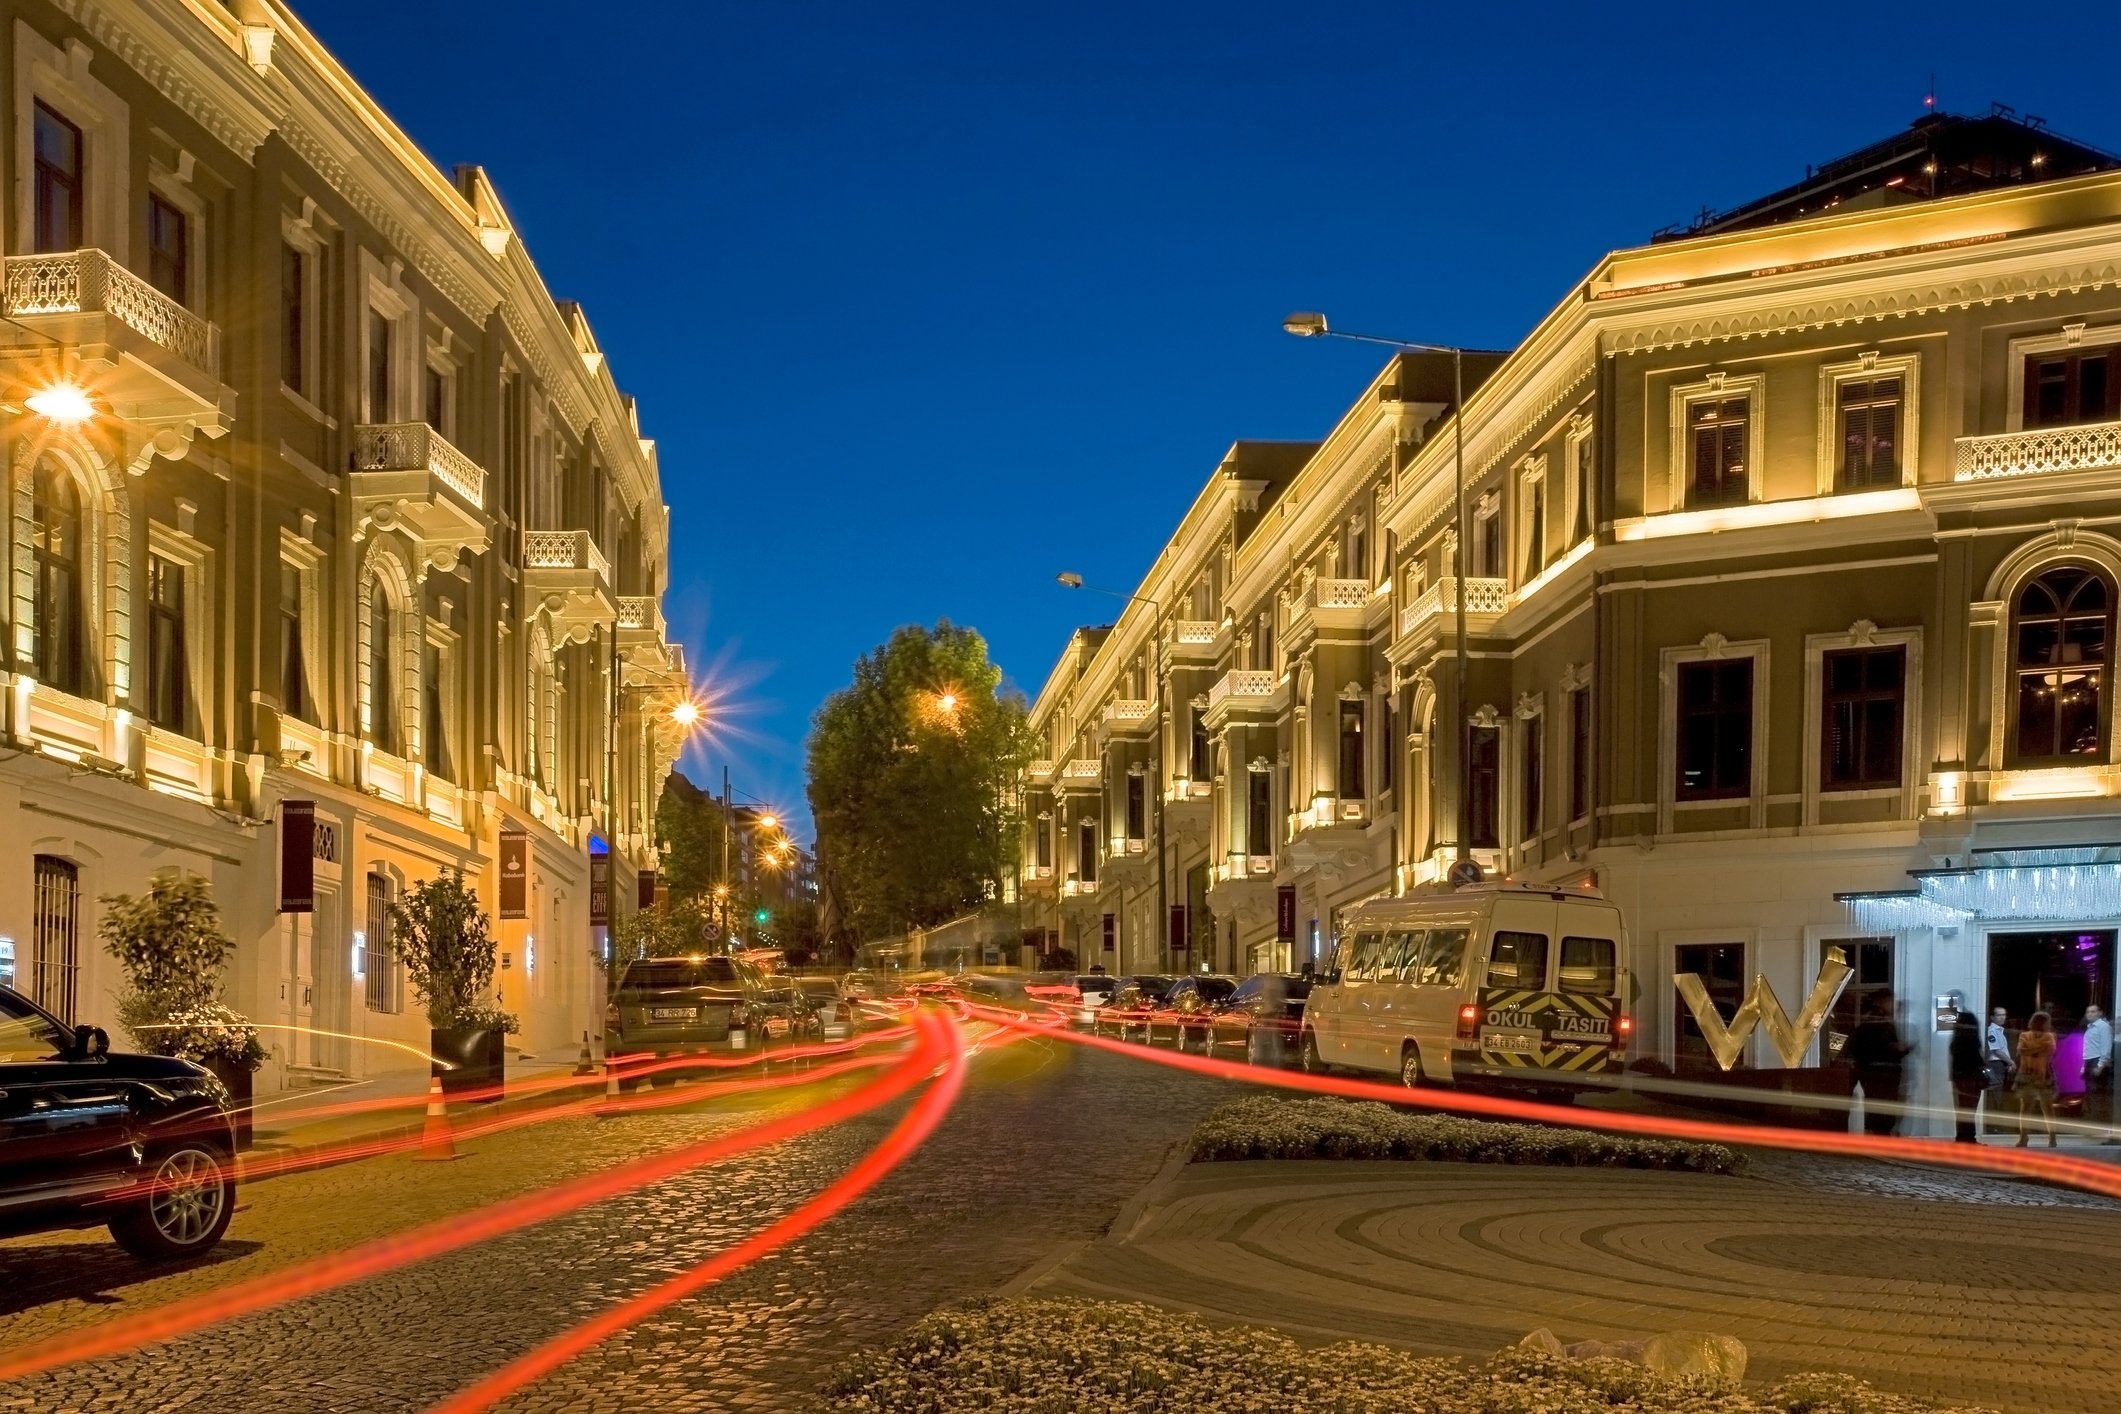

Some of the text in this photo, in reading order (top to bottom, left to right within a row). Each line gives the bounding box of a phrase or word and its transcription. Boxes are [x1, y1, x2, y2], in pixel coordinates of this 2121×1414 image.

[593, 893, 607, 902] CAFE
[593, 903, 607, 912] CITY
[1673, 945, 1855, 1071] W
[656, 1009, 664, 1017] 34
[668, 1009, 679, 1017] RR
[1487, 1011, 1536, 1029] OKUL
[1488, 1038, 1498, 1047] 34
